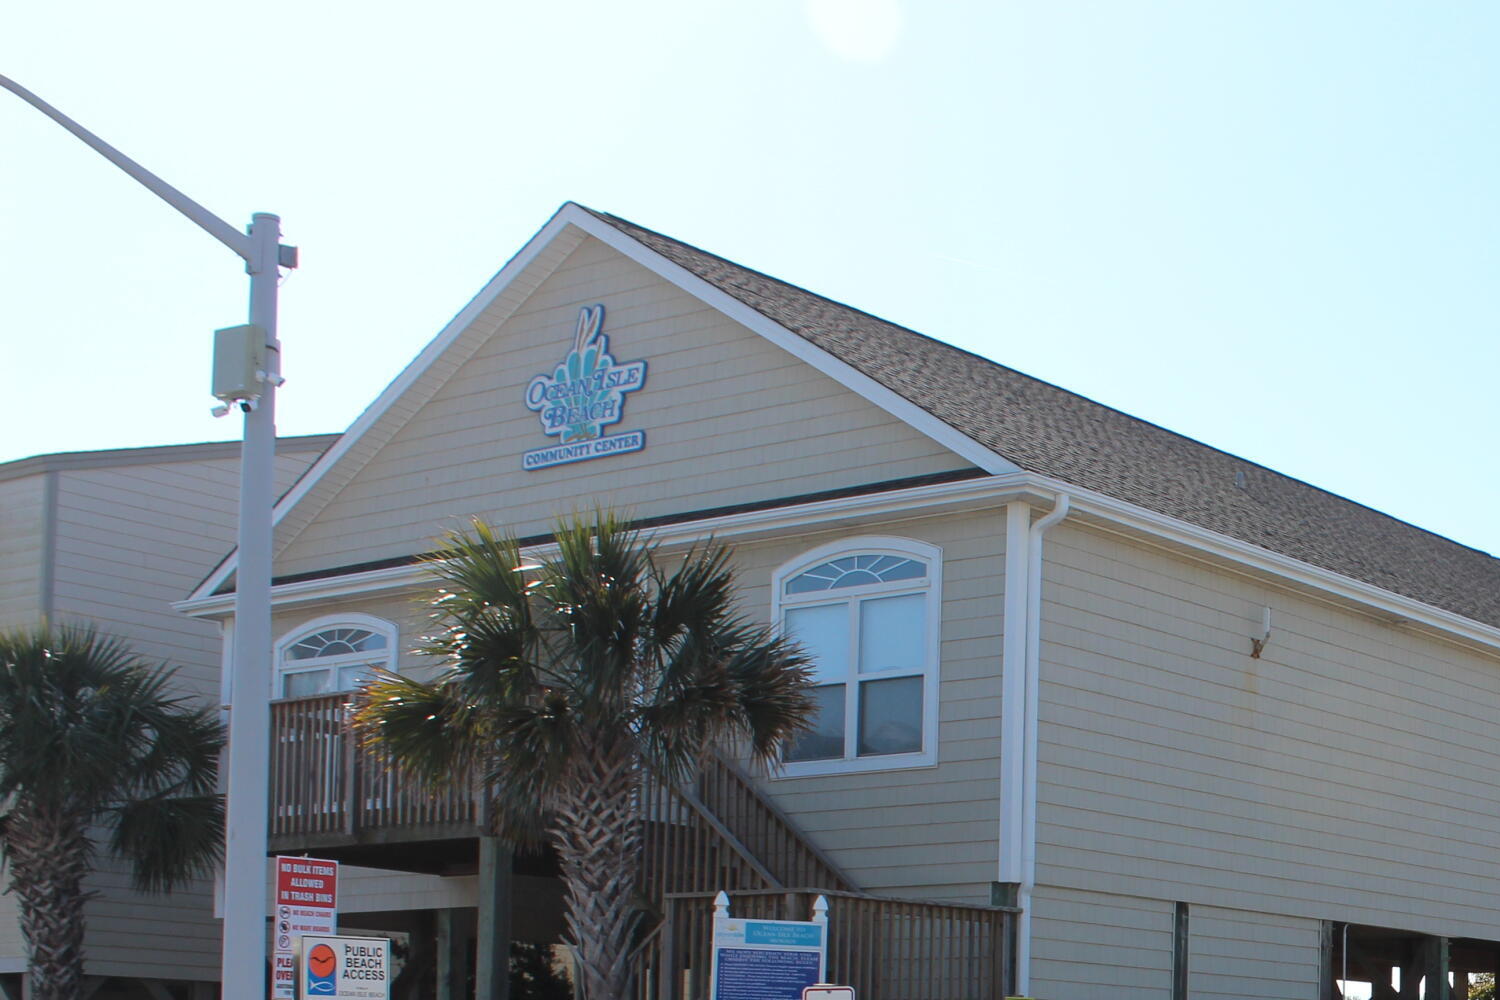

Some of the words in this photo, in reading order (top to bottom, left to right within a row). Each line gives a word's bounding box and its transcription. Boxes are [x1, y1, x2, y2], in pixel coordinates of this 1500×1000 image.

[530, 378, 592, 404] OCEAN
[592, 368, 639, 391] ISLE
[544, 400, 617, 428] BEACH
[526, 442, 592, 466] COMMUNITY
[594, 434, 640, 453] CENTER
[281, 863, 291, 873] NO
[293, 864, 311, 875] BULK
[312, 865, 334, 876] ITEMS
[291, 878, 324, 888] ALLOWED
[281, 891, 289, 900] IN
[291, 891, 314, 902] TRASH
[315, 893, 333, 903] BINS
[345, 945, 382, 958] PUBLIC
[277, 957, 293, 968] PLE
[346, 957, 382, 969] BEACH
[276, 971, 294, 981] OVE
[342, 970, 385, 981] ACCESS
